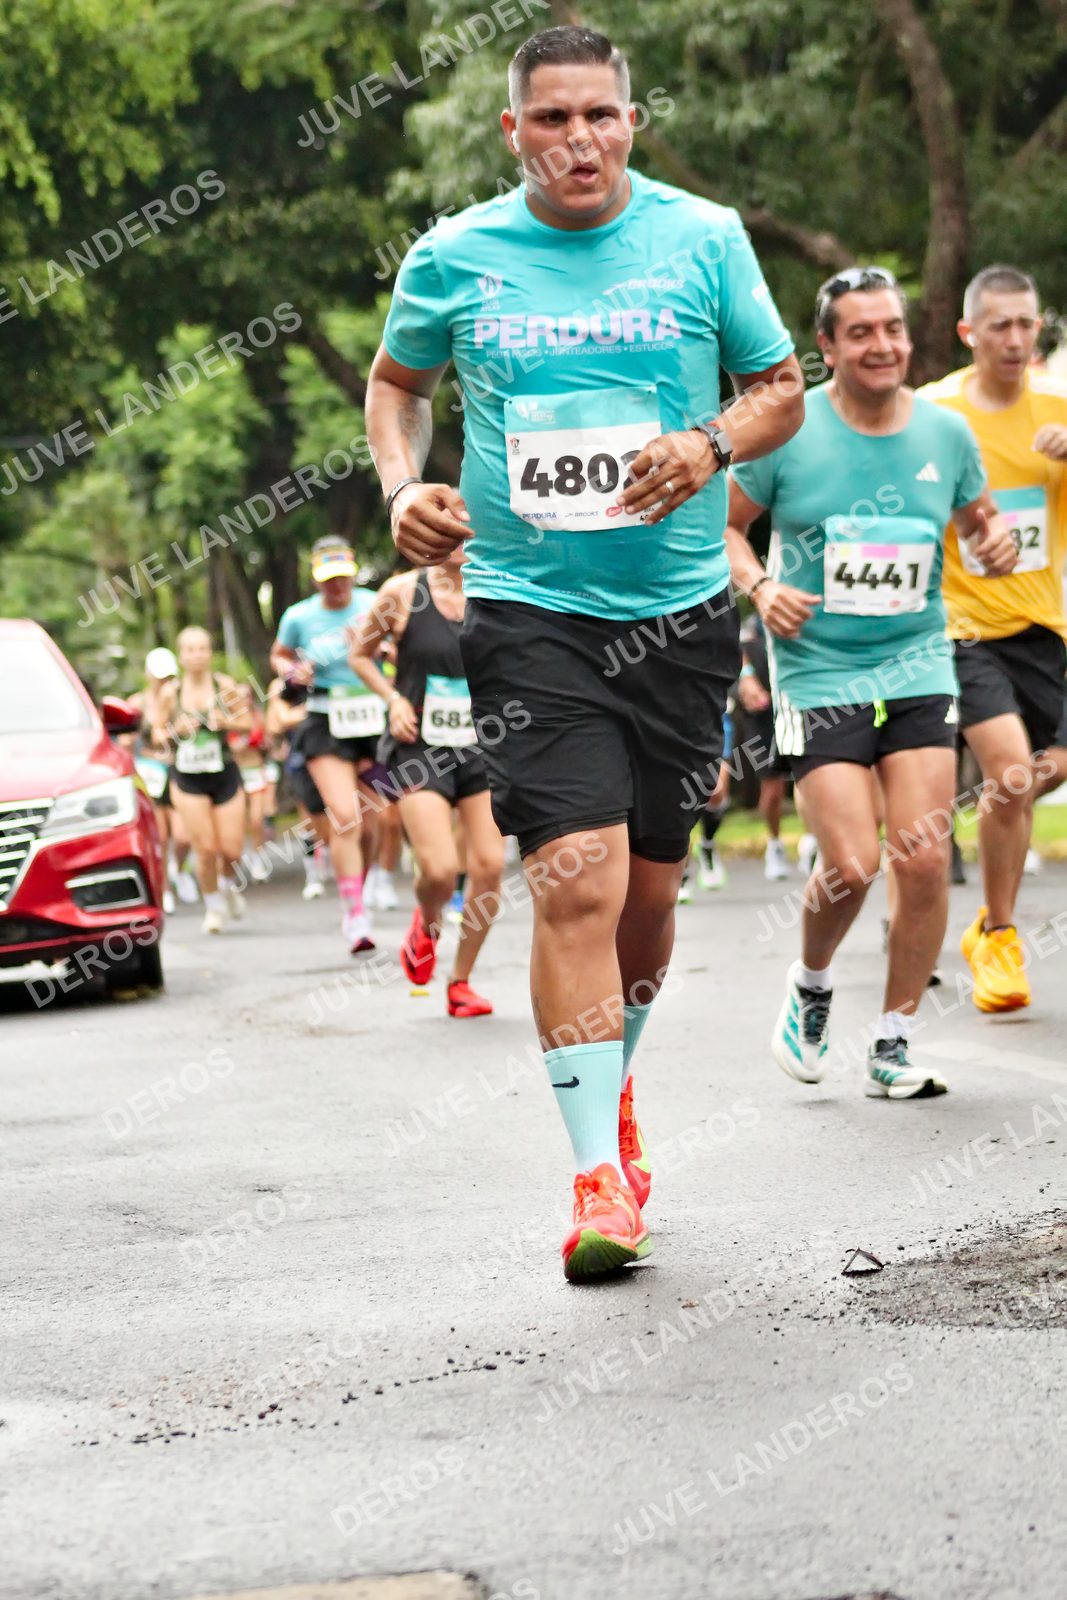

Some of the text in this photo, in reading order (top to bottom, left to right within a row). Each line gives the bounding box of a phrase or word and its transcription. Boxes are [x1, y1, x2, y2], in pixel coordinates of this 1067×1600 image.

[628, 278, 686, 290] BROOKS
[474, 308, 682, 349] PERDURA
[630, 341, 675, 353] ESTUCOS
[834, 561, 920, 590] 4441
